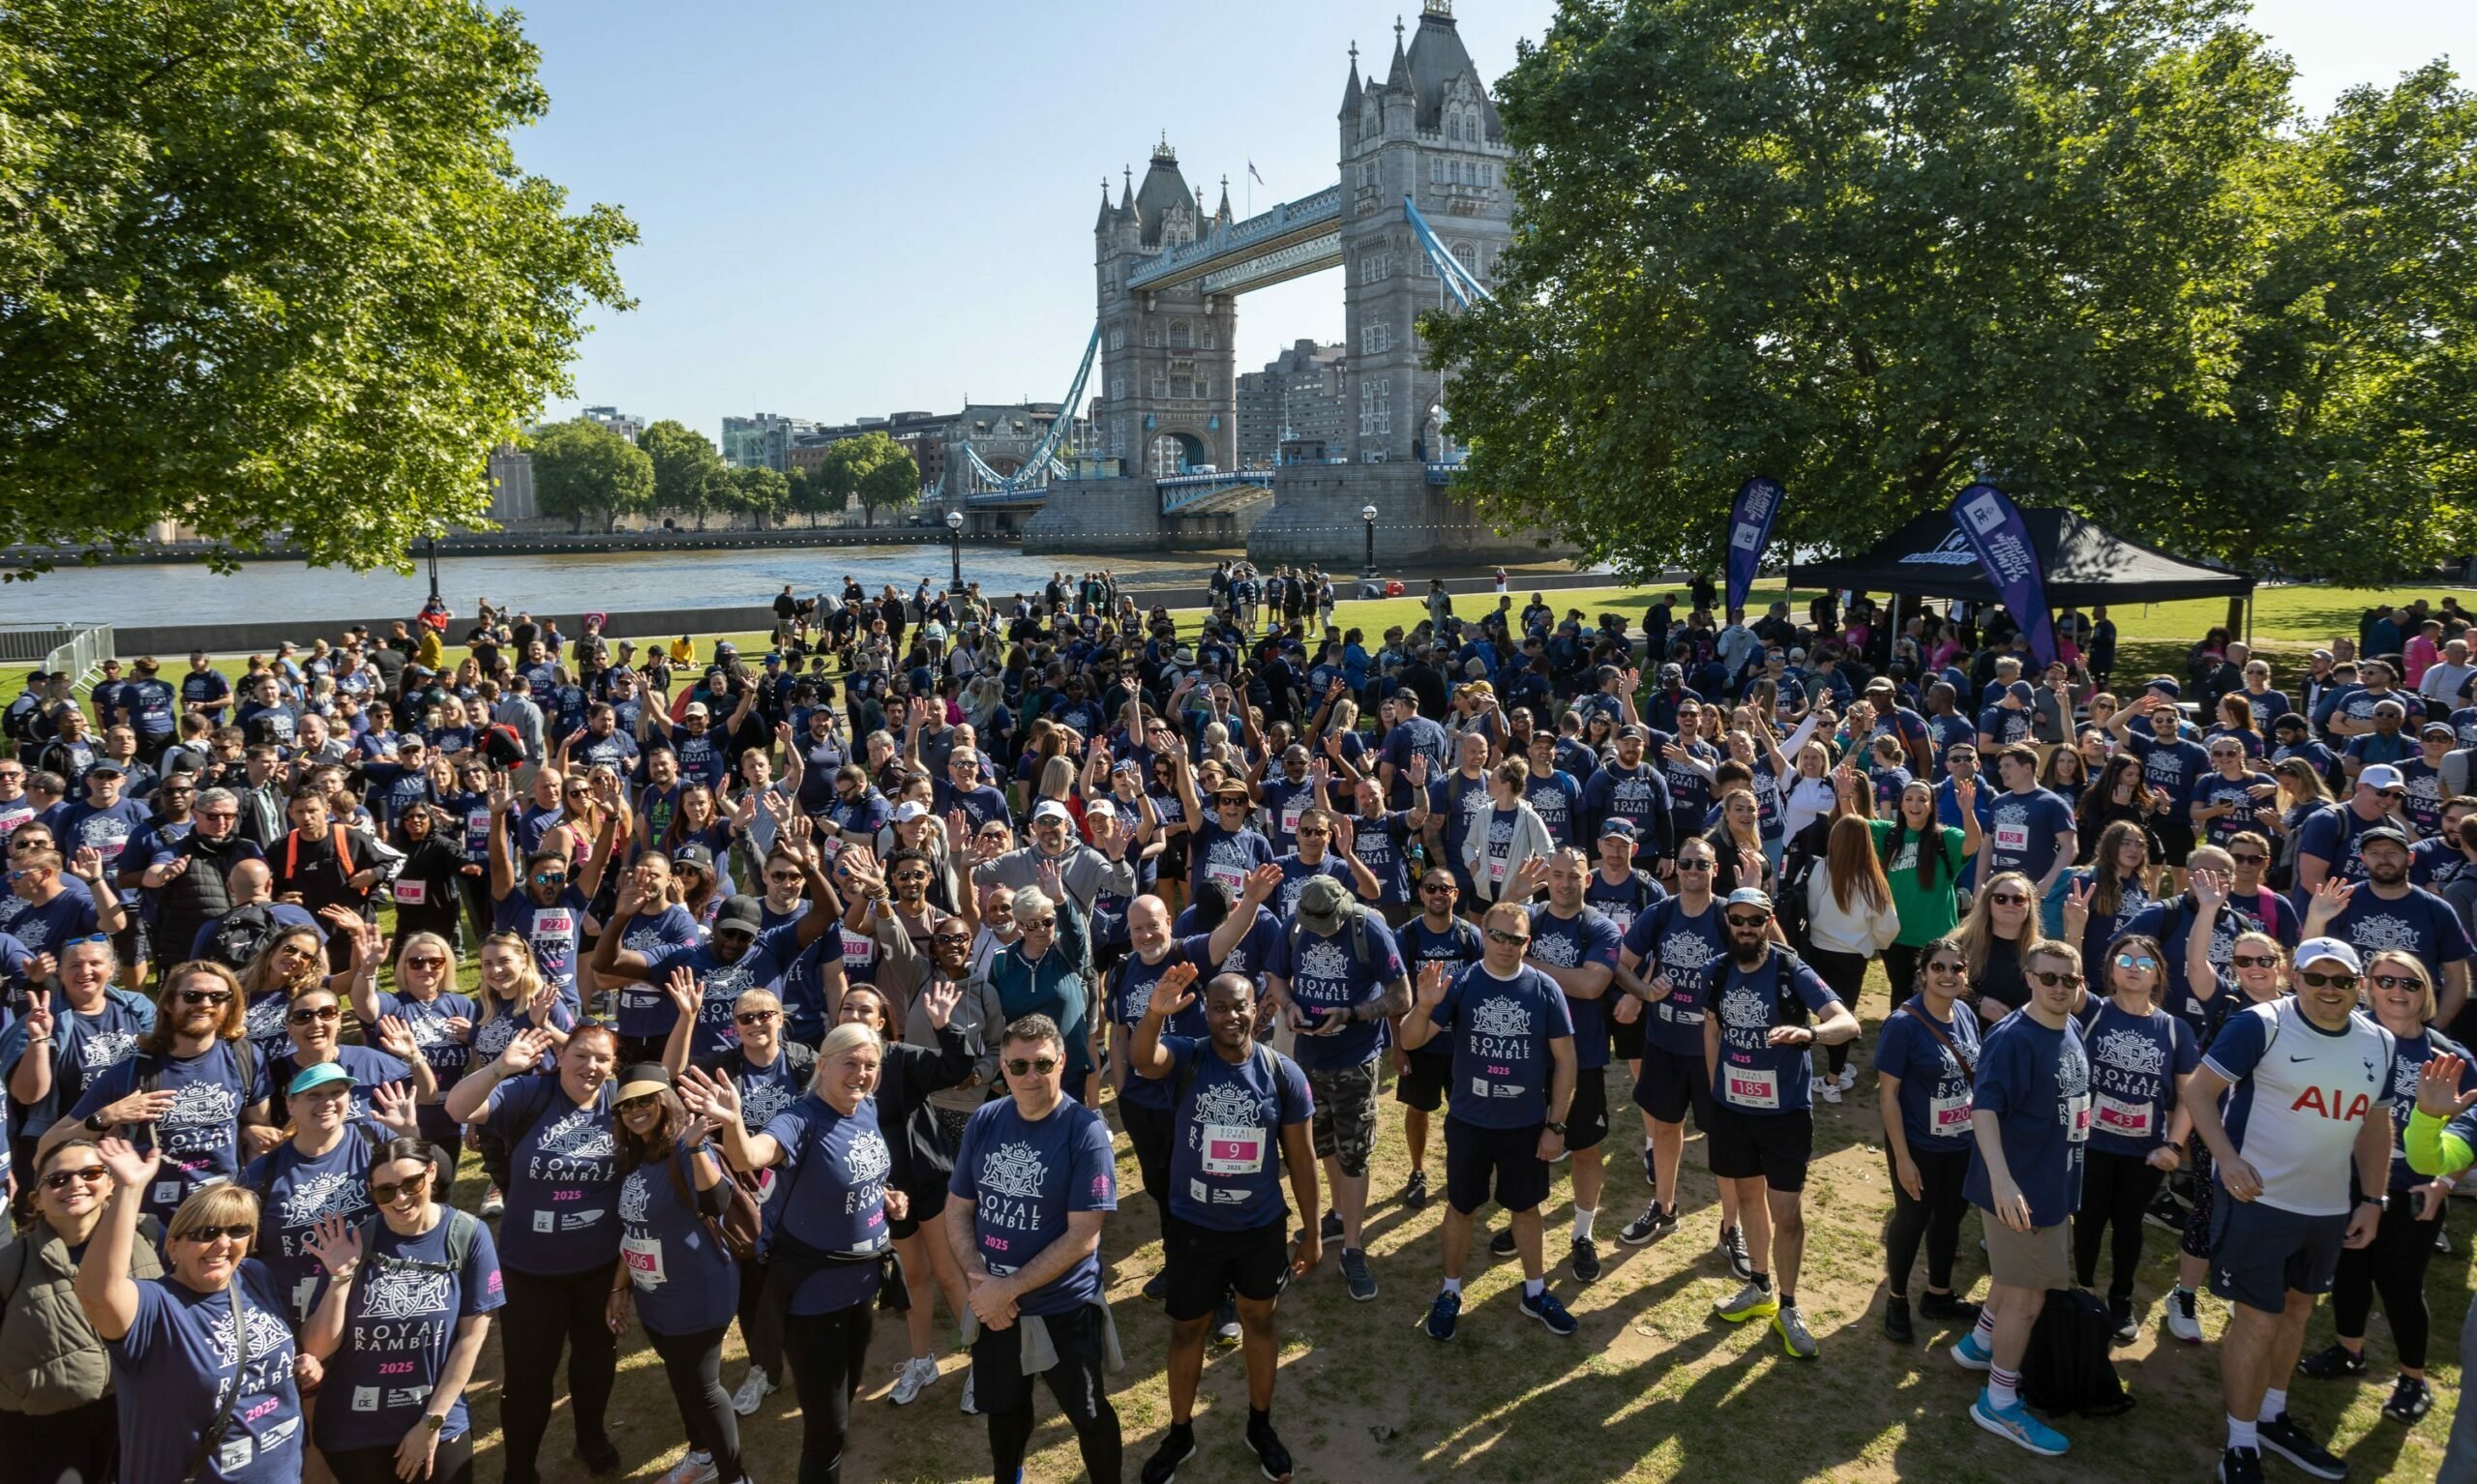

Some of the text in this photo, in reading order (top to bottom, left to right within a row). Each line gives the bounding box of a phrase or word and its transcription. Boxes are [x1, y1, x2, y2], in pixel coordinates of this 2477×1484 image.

[1974, 507, 1989, 525] DE
[1995, 532, 2030, 575] WITHOUT
[2005, 534, 2032, 564] YOUTH
[1988, 544, 2021, 582] LIMITS
[546, 919, 566, 930] 221
[1661, 966, 1702, 980] OYA
[1298, 977, 1349, 993] ROYAL
[1298, 988, 1350, 1001] RAMBLE
[1673, 992, 1692, 1003] 2025
[699, 1000, 735, 1015] ROY
[699, 1011, 734, 1024] RAM
[1470, 1035, 1530, 1050] ROYAL
[1470, 1045, 1530, 1059] RAMBLE
[428, 1056, 467, 1066] MBLE
[1486, 1065, 1509, 1075] 2025
[2092, 1065, 2161, 1091] ROYAL
[1738, 1082, 1763, 1096] 185
[1938, 1080, 1967, 1092] ROY
[2092, 1075, 2159, 1098] RAMBLE
[2290, 1085, 2369, 1122] AIA
[1946, 1107, 1969, 1123] 220
[2112, 1113, 2134, 1127] 43
[166, 1134, 233, 1155] AMBLE
[1229, 1143, 1239, 1158] 9
[531, 1155, 615, 1173] ROYAL
[529, 1169, 613, 1181] RAMBLE
[552, 1190, 582, 1201] 2025
[622, 1222, 653, 1240] YAL
[984, 1234, 1008, 1251] 2025
[626, 1252, 648, 1269] 206
[354, 1319, 446, 1341] ROYAL
[354, 1333, 442, 1351] RAMBLE
[378, 1361, 415, 1375] 2025
[245, 1396, 279, 1423] 2025
[358, 1399, 373, 1408] DE
[229, 1453, 245, 1466] DE
